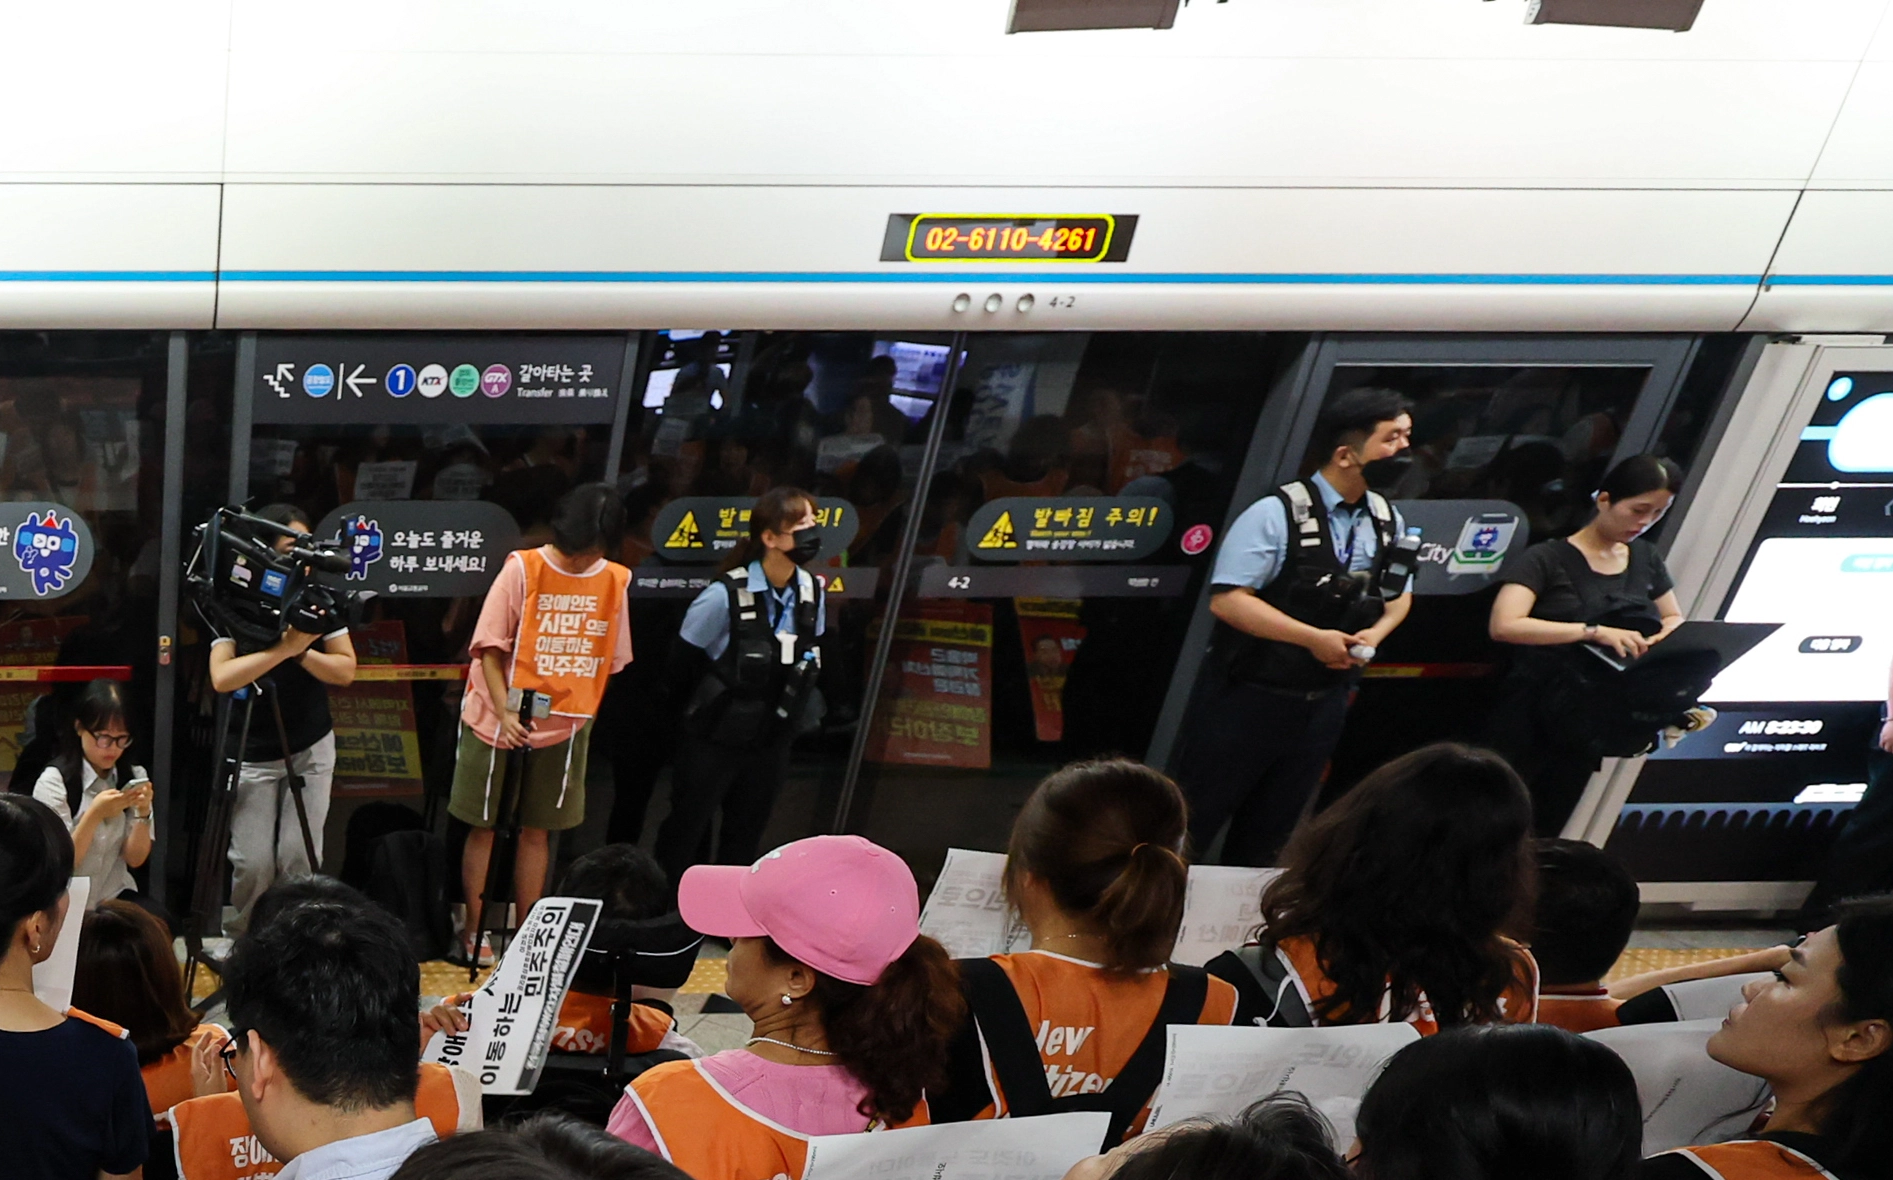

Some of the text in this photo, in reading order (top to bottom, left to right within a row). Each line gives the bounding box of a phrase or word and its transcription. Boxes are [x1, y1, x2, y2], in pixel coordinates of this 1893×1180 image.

[924, 226, 1098, 252] 02-6110-4261
[1048, 295, 1076, 309] 4-2
[394, 369, 406, 391] 1
[420, 375, 446, 387] KTX
[484, 372, 509, 384] GTX
[518, 363, 594, 383] 갈아타는 곳
[516, 386, 555, 399] Transfer
[1033, 506, 1159, 528] 발빠짐 주의!
[390, 530, 484, 549] 오늘도 즐거운
[1415, 542, 1453, 565] City
[388, 555, 487, 573] 하루 보내세요!
[947, 575, 971, 590] 4-2
[537, 593, 599, 613] 장애인도
[535, 635, 594, 655] 이동하는
[1738, 720, 1766, 735] AM
[523, 905, 568, 998] 민주주의
[479, 992, 523, 1086] 이동하는
